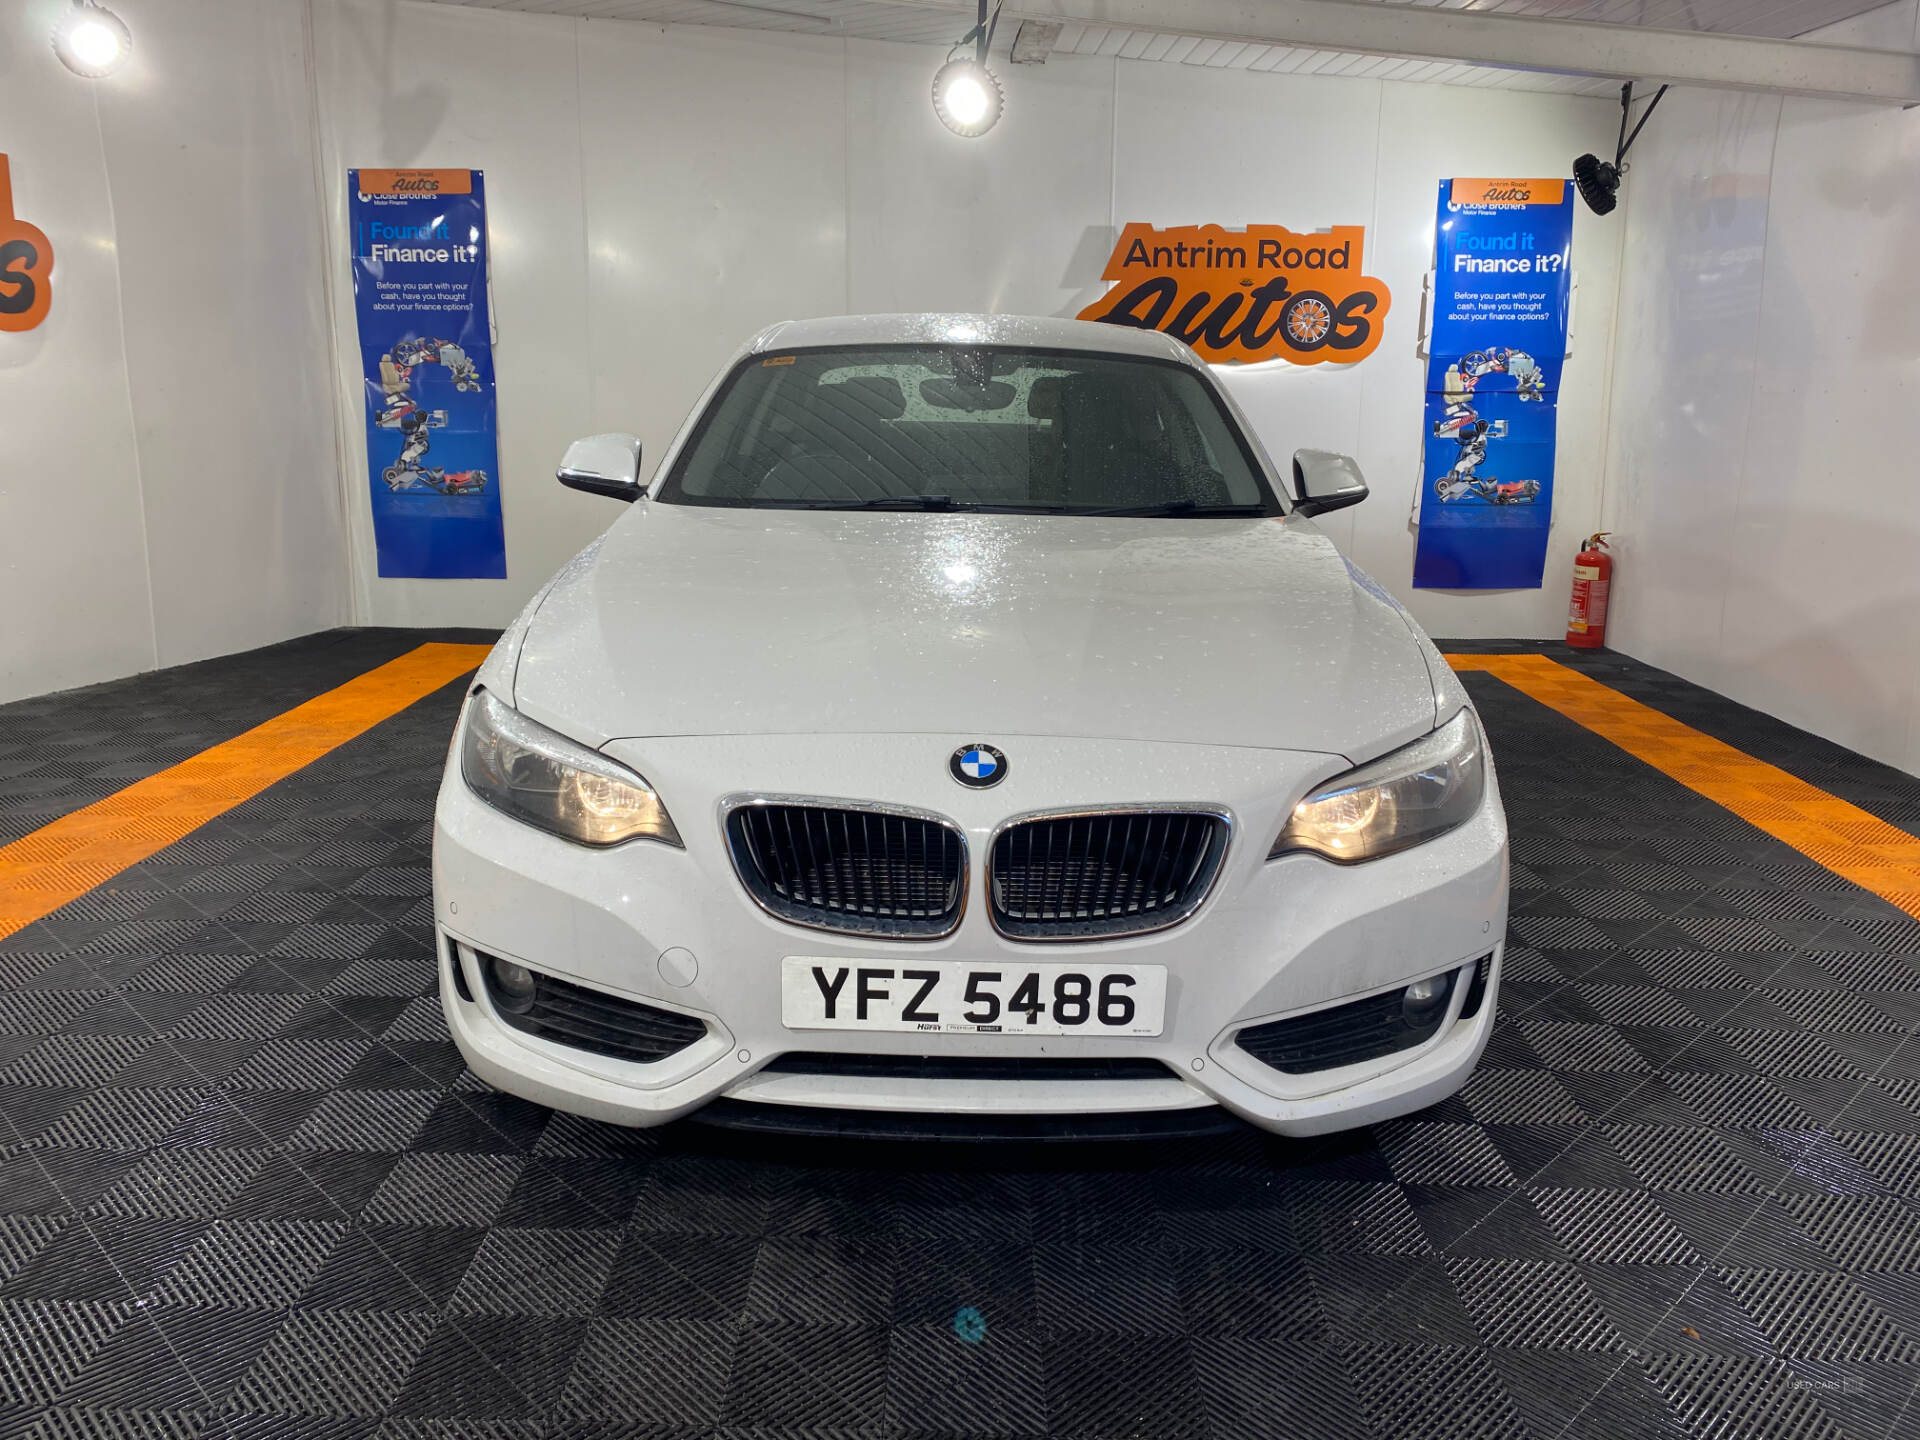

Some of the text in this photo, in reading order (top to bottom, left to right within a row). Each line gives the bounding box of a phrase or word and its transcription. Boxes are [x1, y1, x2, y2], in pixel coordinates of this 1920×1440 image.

[392, 179, 439, 191] Autos
[1482, 188, 1531, 201] Autos
[370, 222, 450, 240] Found it
[1456, 232, 1535, 250] Found it
[371, 244, 477, 263] Finance it?
[1122, 238, 1350, 270] Antrim Road
[1454, 254, 1561, 272] Finance it?
[376, 282, 468, 292] Before you part with your
[437, 293, 466, 301] thought
[443, 303, 474, 311] options?
[1095, 276, 1378, 352] Autos
[1513, 303, 1542, 311] thought
[1517, 313, 1549, 321] options?
[956, 744, 1003, 758] BMW
[811, 966, 1136, 1025] YFZ 5486
